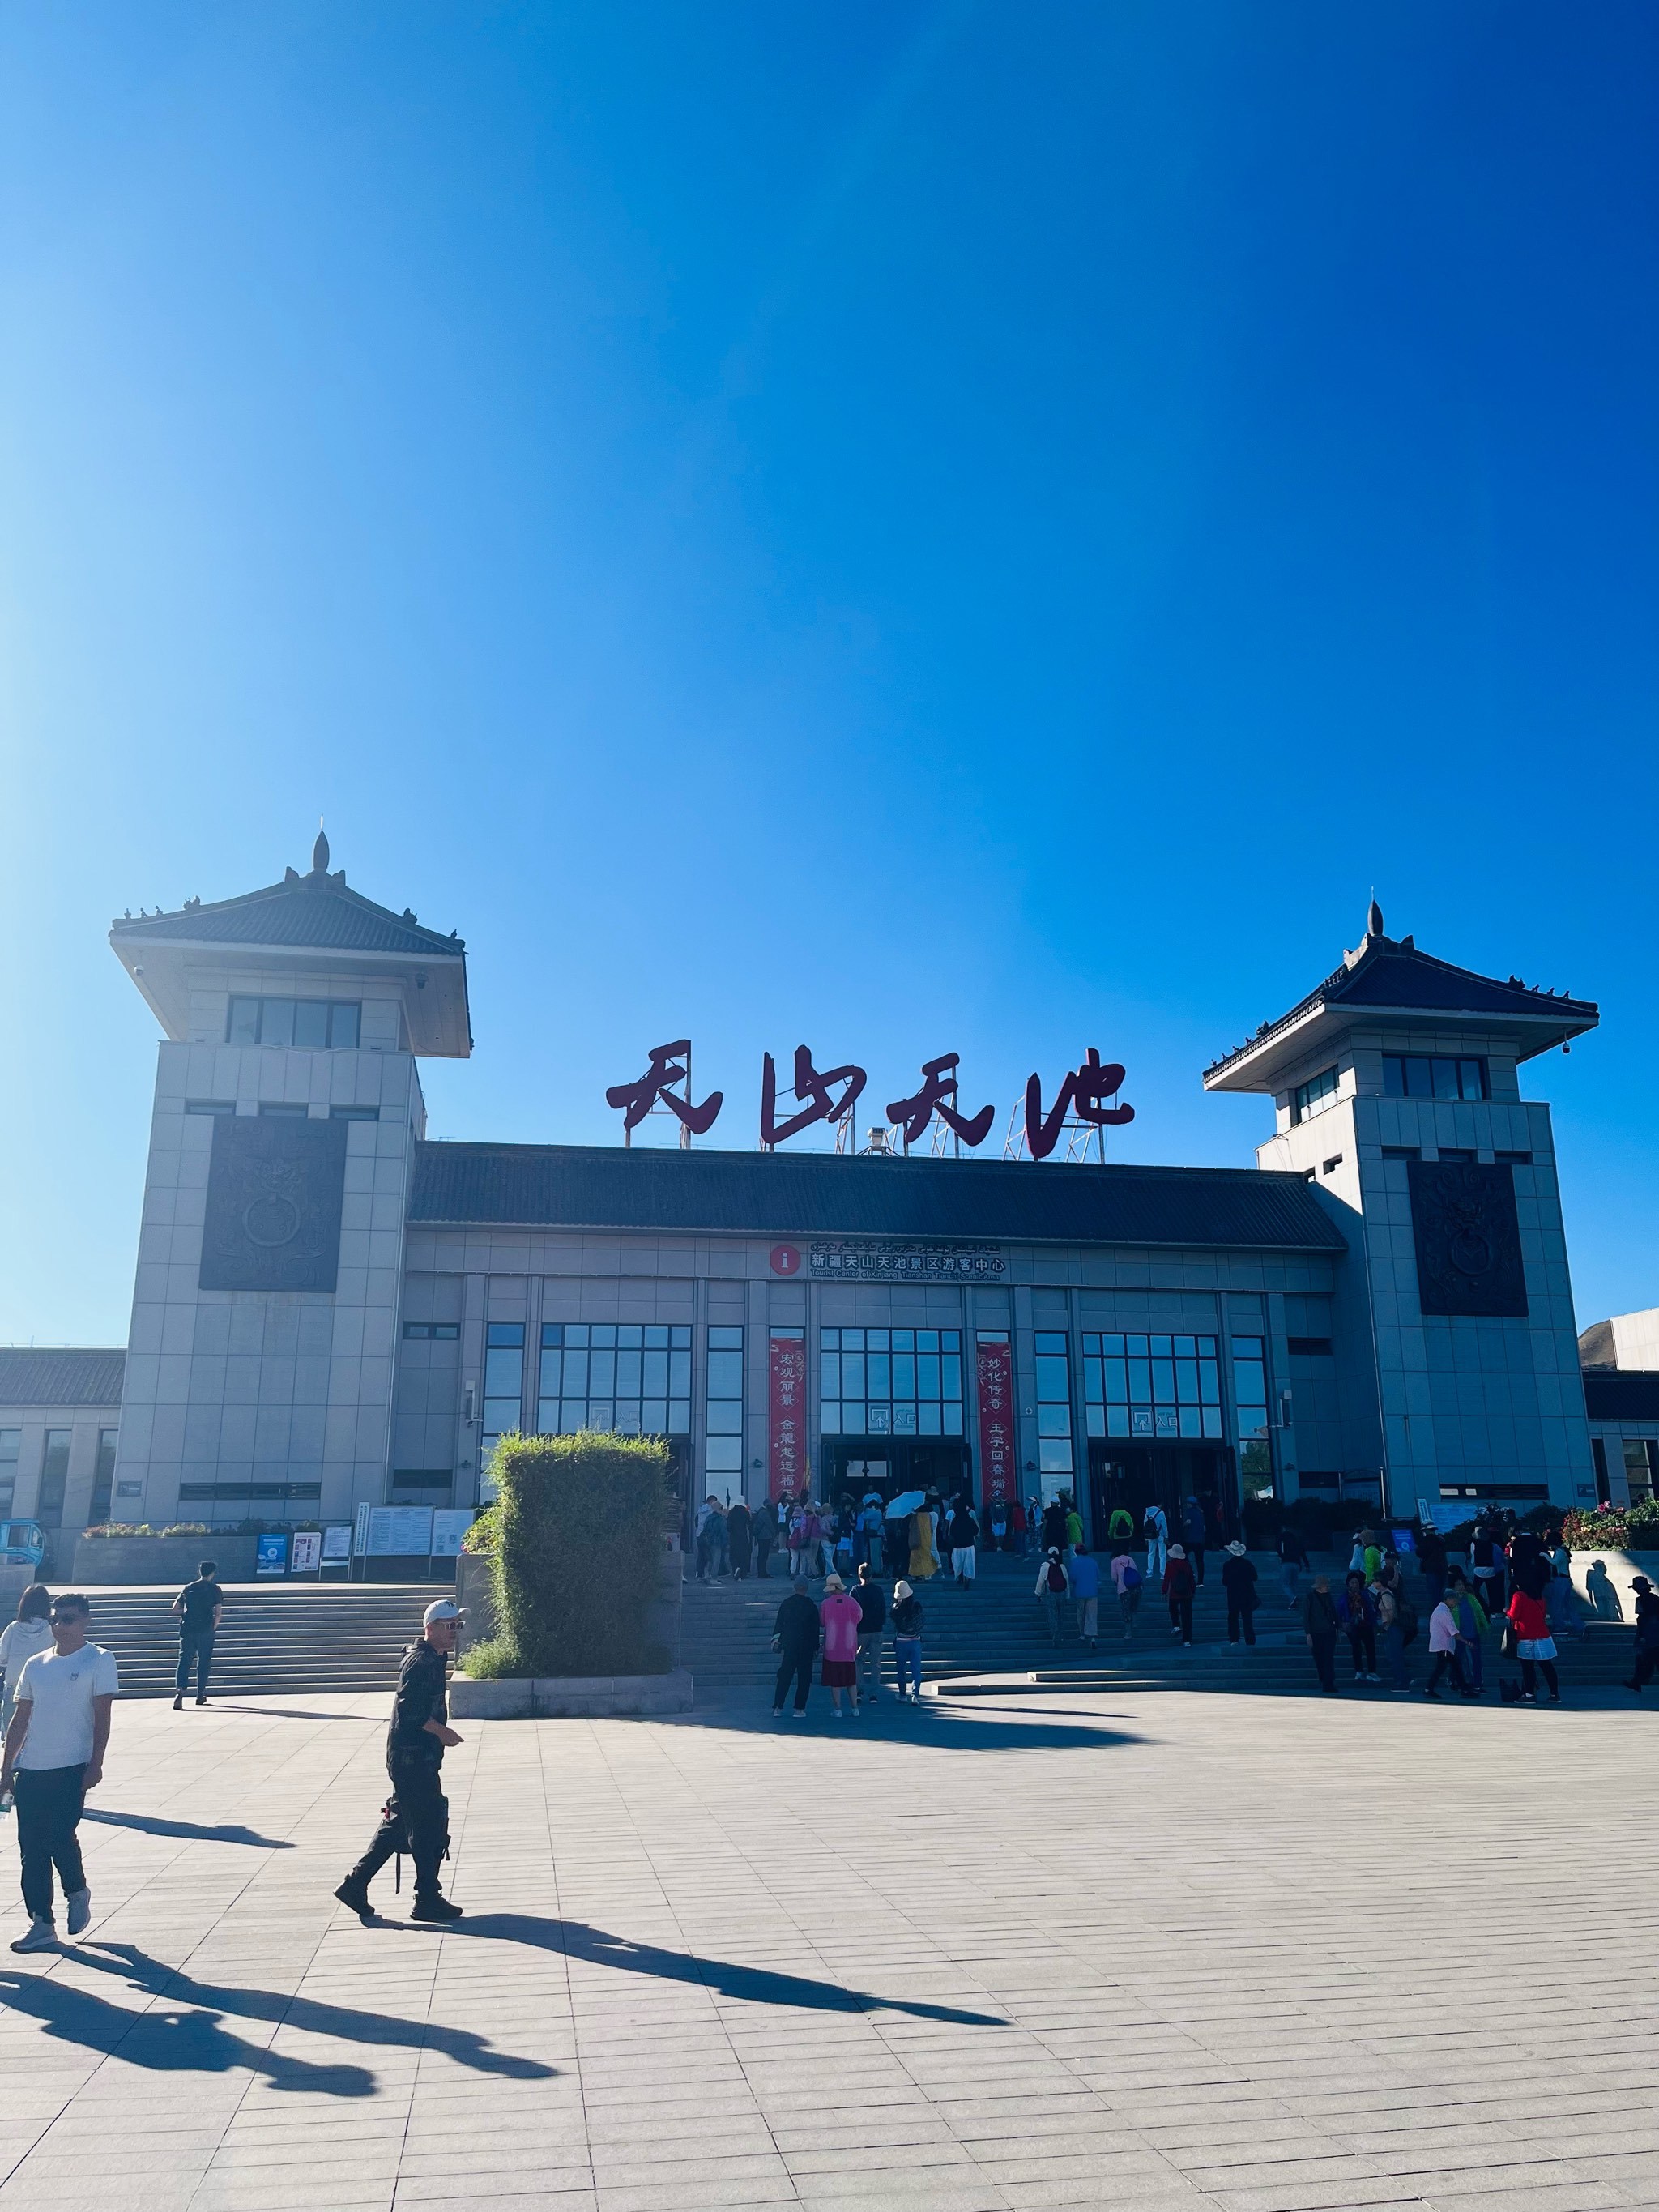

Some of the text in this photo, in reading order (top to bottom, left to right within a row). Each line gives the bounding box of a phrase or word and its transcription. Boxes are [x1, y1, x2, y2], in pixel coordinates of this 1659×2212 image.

[606, 1040, 1135, 1159] 天山天池
[812, 1253, 1004, 1272] 新疆天山天池景区游客中心
[870, 1270, 898, 1279] Xinjiang
[780, 1354, 795, 1406] 宏观丽景
[616, 1411, 639, 1423] 入口
[893, 1413, 916, 1424] 入口
[1156, 1416, 1178, 1427] 入口
[987, 1358, 1006, 1502] 妙化传奇 玉宇回春瑞
